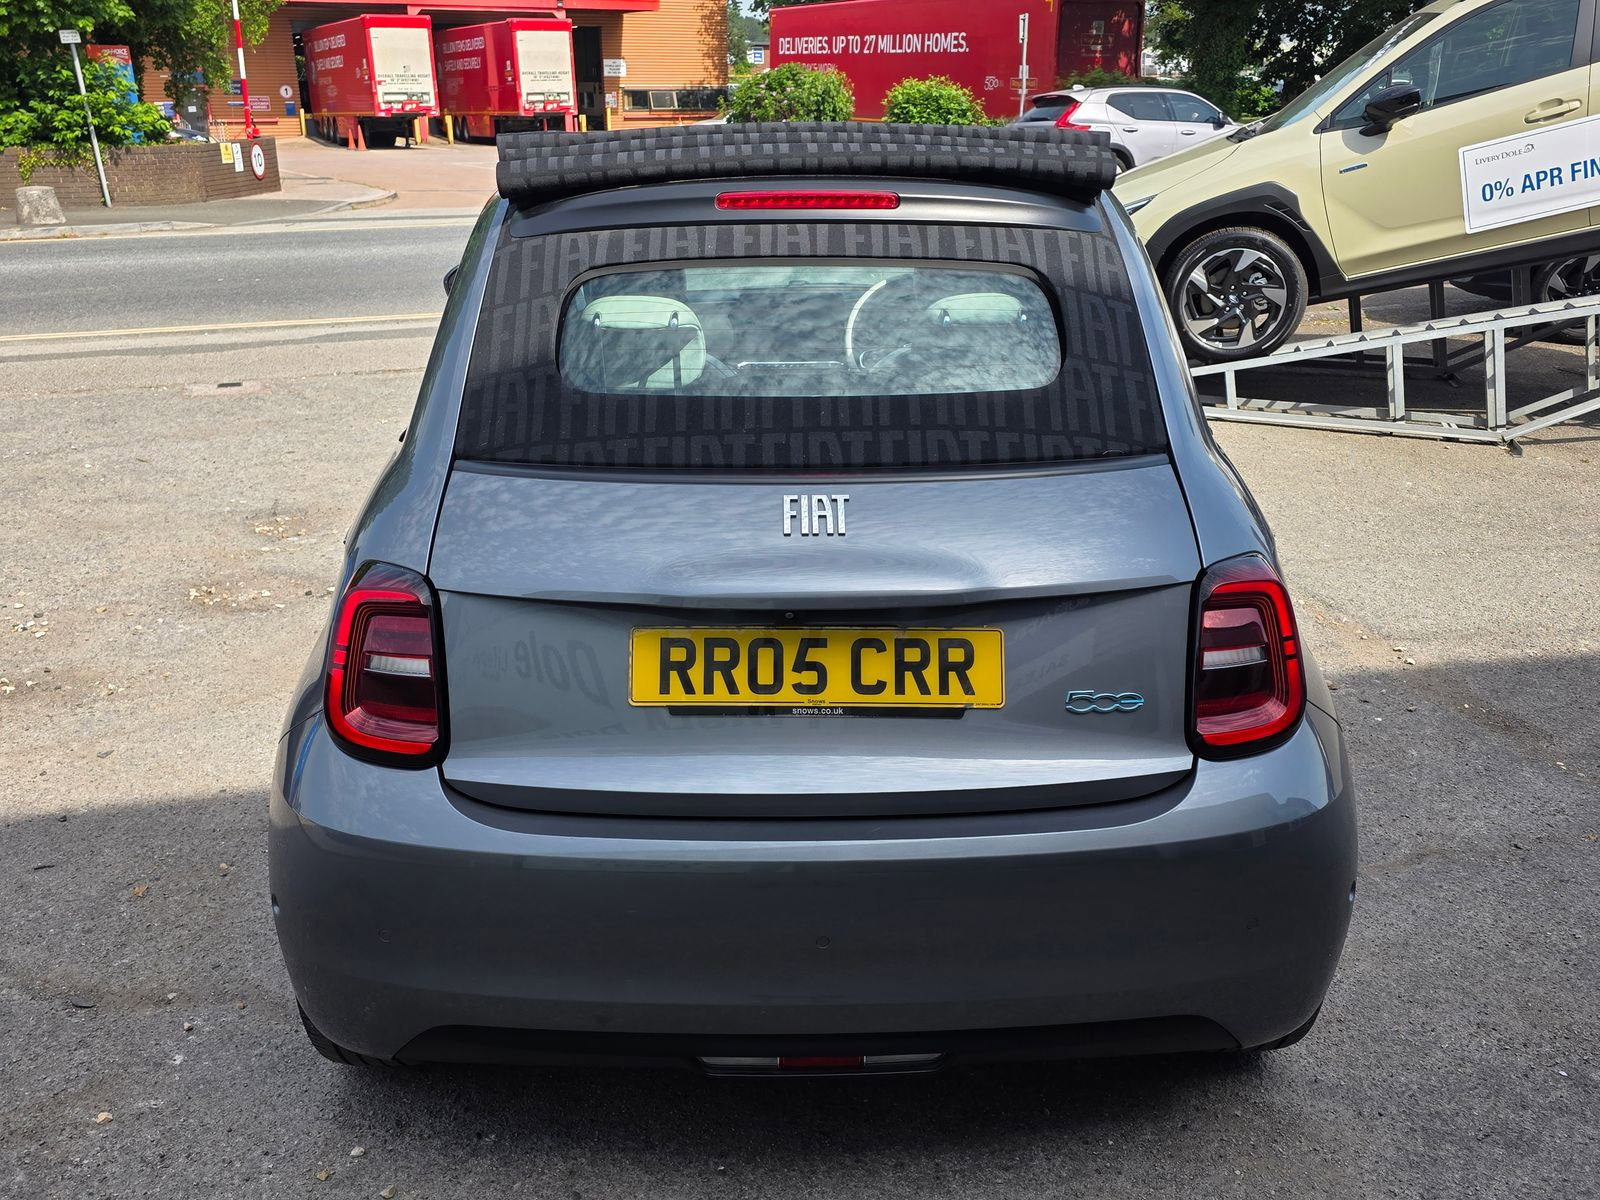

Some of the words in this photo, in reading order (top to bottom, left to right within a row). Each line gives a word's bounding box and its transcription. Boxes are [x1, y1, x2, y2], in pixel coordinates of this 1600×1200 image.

[779, 36, 831, 55] DELIVERIES.
[832, 35, 847, 54] UP
[848, 35, 861, 54] TO
[863, 34, 876, 54] 27
[877, 33, 922, 53] MILLION
[924, 32, 970, 53] HOMES.
[254, 152, 263, 168] 10
[1481, 178, 1514, 202] 0%
[1521, 167, 1563, 193] APR
[783, 494, 850, 537] FIAT
[659, 636, 829, 696] RR05
[850, 636, 975, 696] CRR
[792, 706, 844, 716] snows.co.uk
